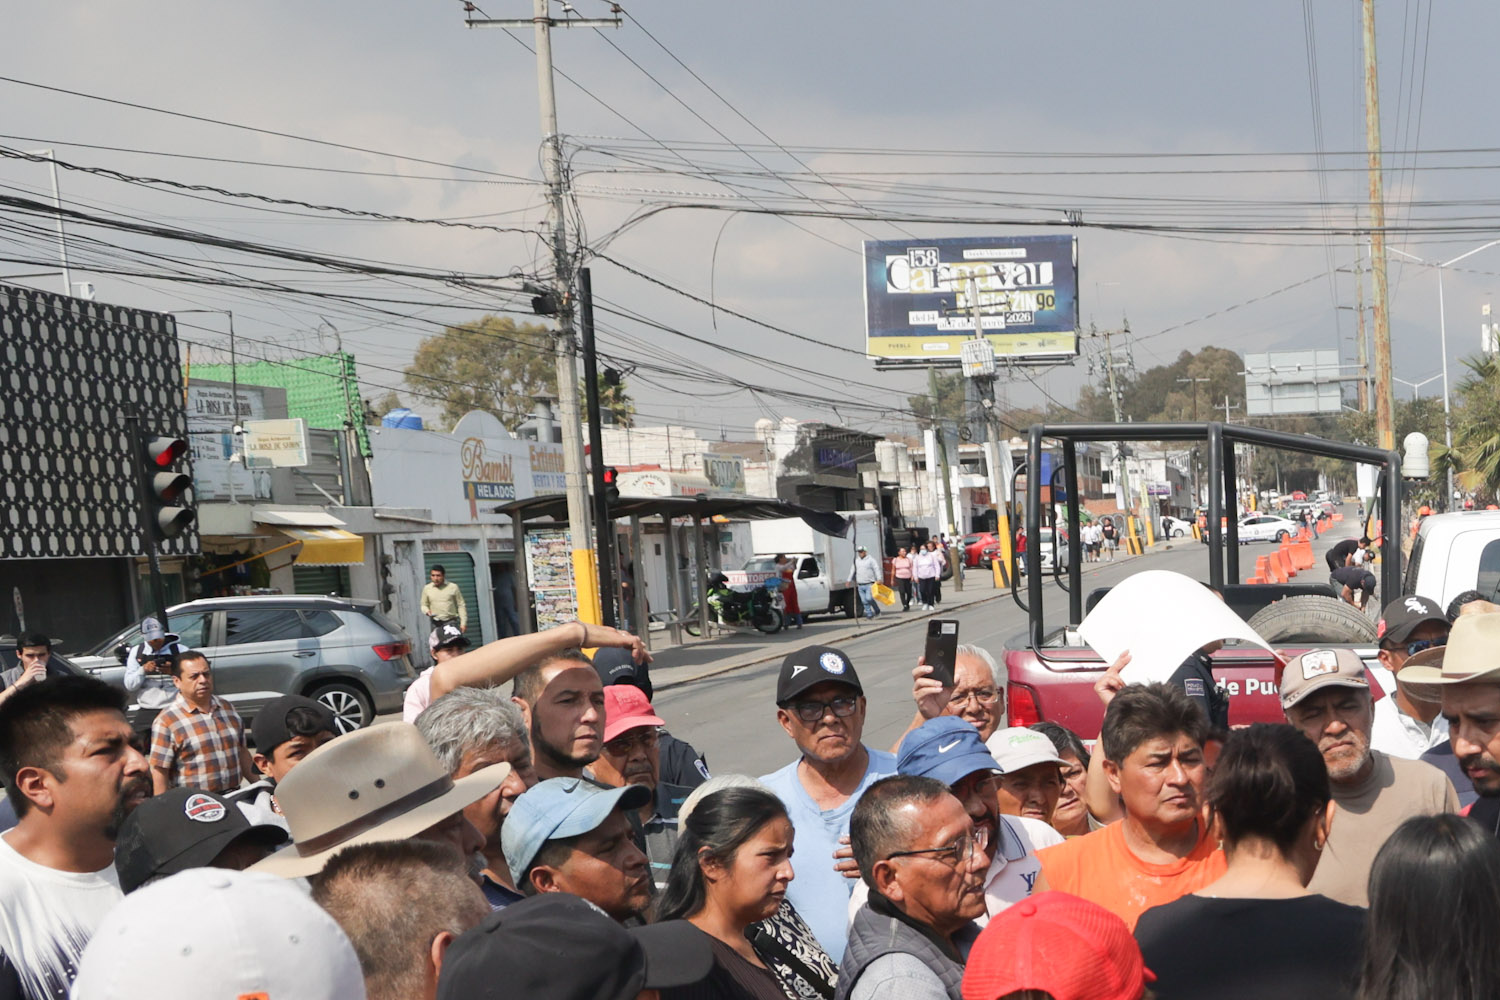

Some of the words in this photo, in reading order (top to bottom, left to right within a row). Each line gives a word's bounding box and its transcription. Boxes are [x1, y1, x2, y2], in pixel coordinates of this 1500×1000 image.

[909, 249, 937, 267] 158
[970, 317, 1003, 327] ferero
[1006, 312, 1031, 323] 2026
[529, 445, 565, 473] Extinto
[477, 484, 515, 498] HELADOS
